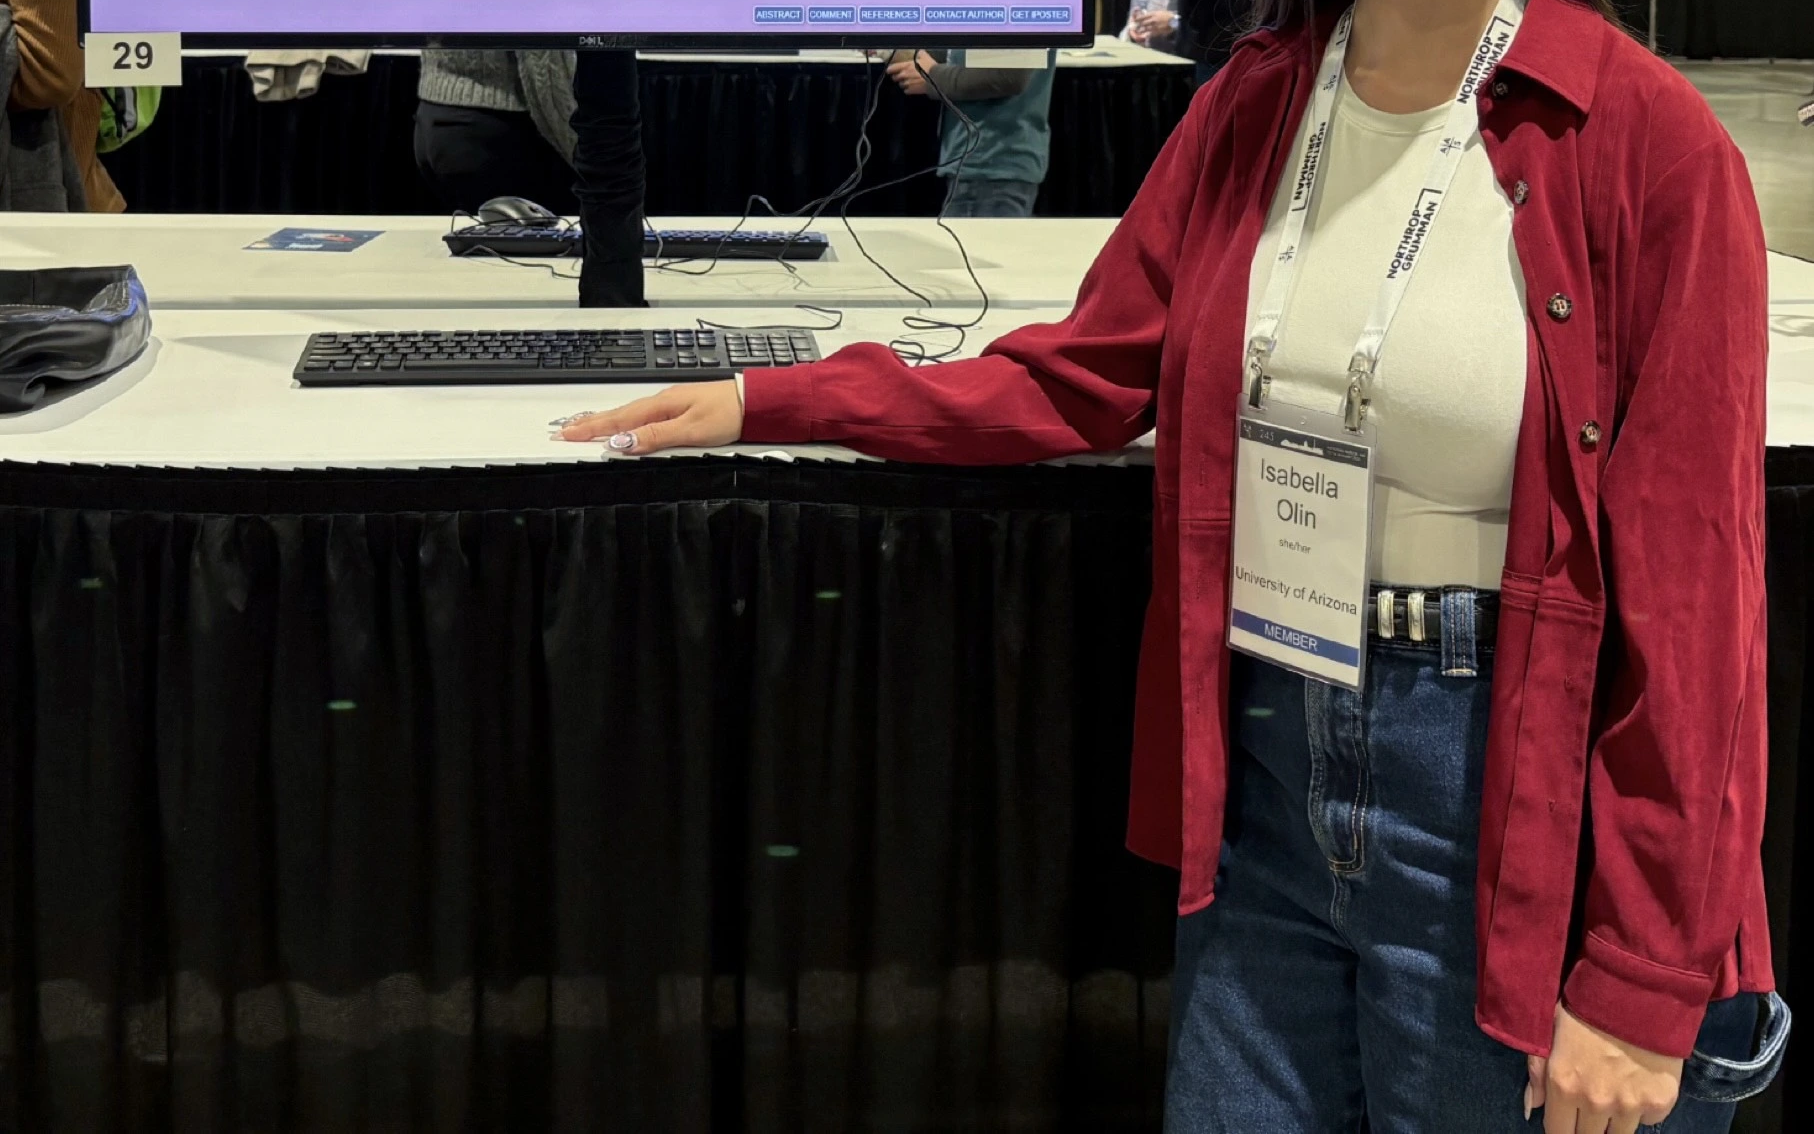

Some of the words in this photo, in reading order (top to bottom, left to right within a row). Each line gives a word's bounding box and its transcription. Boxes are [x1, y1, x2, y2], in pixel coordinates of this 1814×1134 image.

[757, 11, 800, 19] ABSTRACT
[810, 11, 853, 19] COMMENT
[861, 11, 918, 19] REFERENCES
[927, 11, 968, 19] CONTACT
[968, 11, 1004, 19] AUTHOR
[1013, 11, 1029, 19] GET
[113, 42, 153, 69] 29
[1457, 36, 1493, 104] NORTHROP
[1294, 133, 1317, 200] GRUMMAN
[1305, 122, 1326, 188] NORTHROP
[1387, 208, 1423, 279] NORTHROP
[1402, 201, 1437, 271] GRUMMAN
[1261, 458, 1338, 499] Isabella
[1277, 499, 1317, 529] Olin
[1279, 538, 1311, 554] she/her
[1235, 566, 1290, 598] University
[1294, 586, 1307, 599] of
[1309, 590, 1357, 615] Arizona
[1265, 623, 1317, 651] MEMBER
